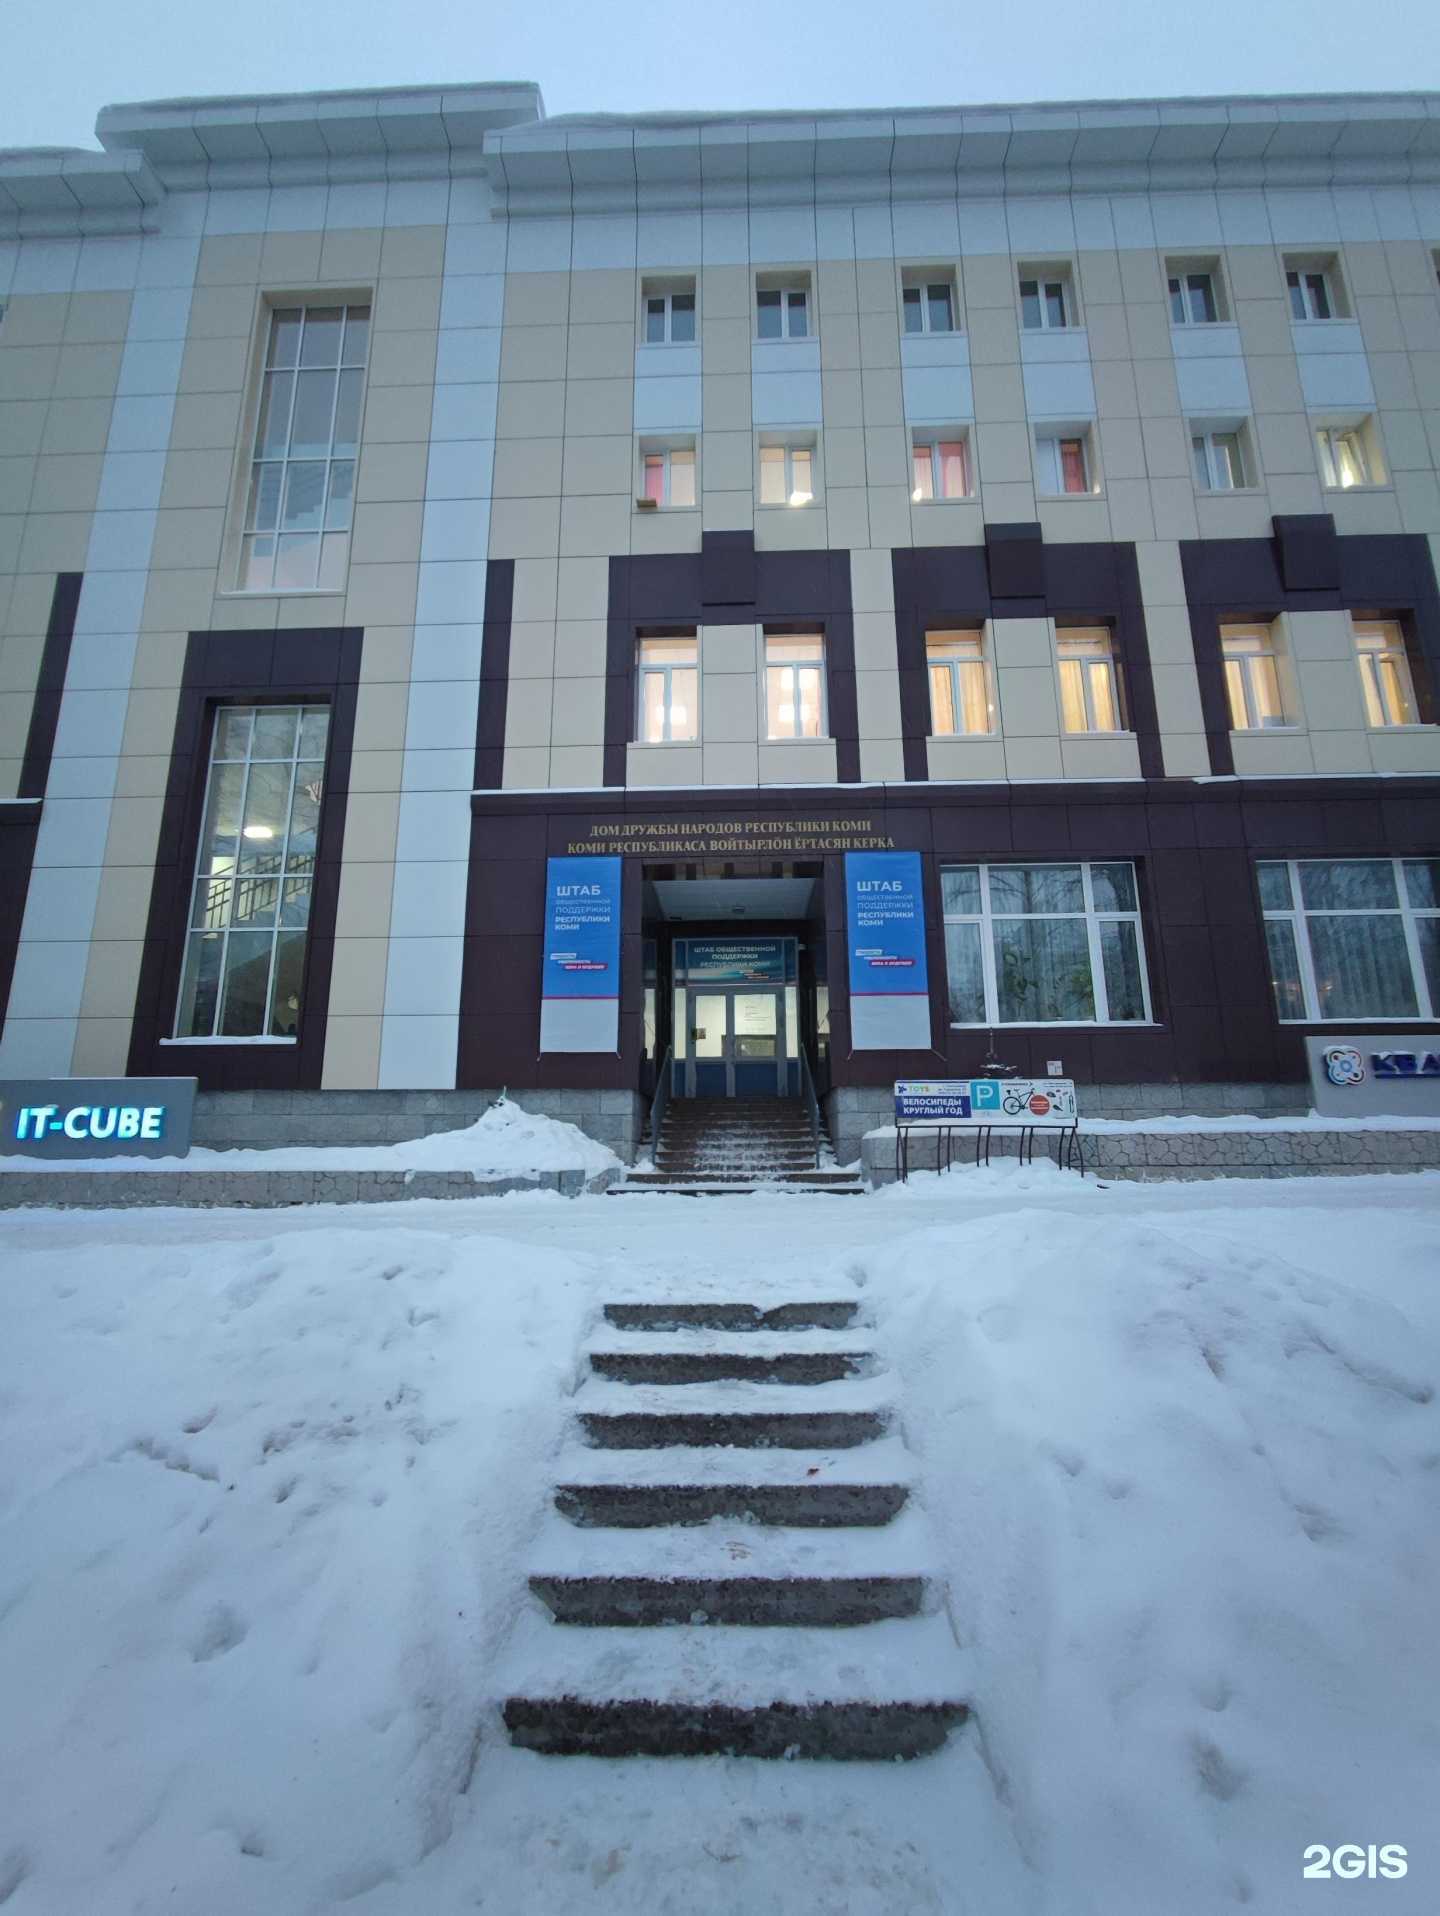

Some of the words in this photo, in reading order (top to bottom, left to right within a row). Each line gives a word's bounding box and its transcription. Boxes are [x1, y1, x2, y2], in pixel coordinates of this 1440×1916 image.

[590, 825, 619, 837] ДОМ
[621, 823, 678, 836] ДРУЖБЫ
[681, 822, 742, 835] НАРОДОВ
[745, 821, 829, 833] РЕСПУБЛИКИ
[832, 820, 871, 832] КОМИ
[568, 842, 605, 854] КОМИ
[609, 840, 706, 853] РЕСПУБЛИКАСА
[853, 836, 895, 849] КЕРКА
[856, 880, 903, 892] ШТАБ
[556, 885, 601, 897] ШТАБ
[857, 901, 914, 910] ПОДДЕРЖКИ
[554, 915, 610, 923] РЕСПУБЛИКИ
[857, 911, 915, 919] РЕСПУБЛИКИ
[554, 923, 580, 931] КОМИ
[858, 919, 884, 927] КОМИ
[716, 944, 776, 953] ОБЩЕСТВЕННОЙ
[903, 1098, 962, 1107] ВЕЛОСИПЕДЫ
[903, 1106, 944, 1114] КРУГЛЫЙ
[945, 1106, 963, 1115] ГОД
[16, 1106, 164, 1139] IT-CUBE
